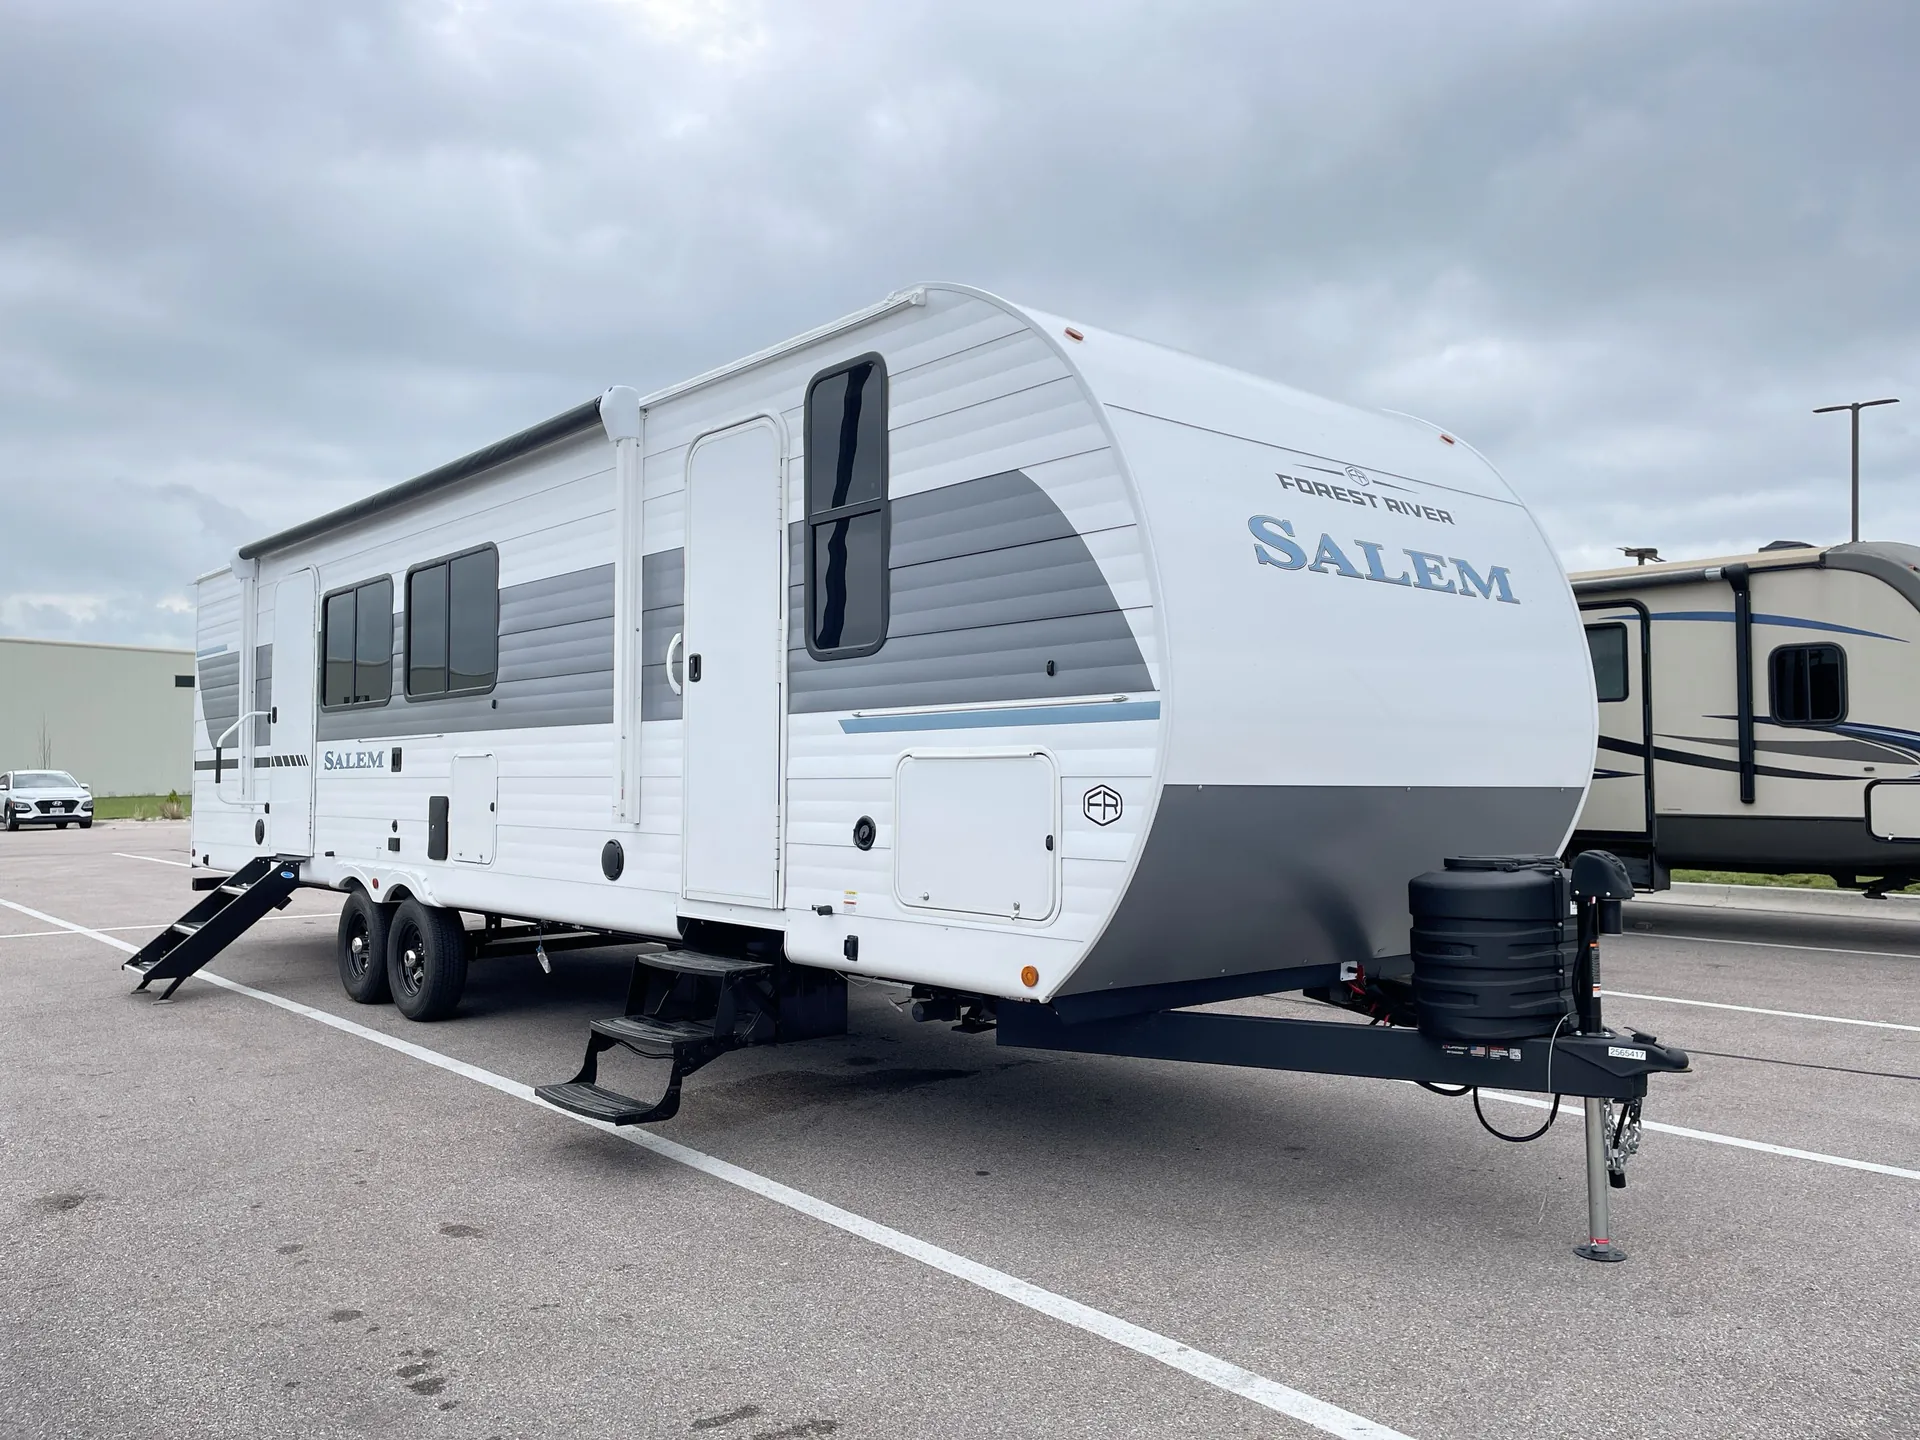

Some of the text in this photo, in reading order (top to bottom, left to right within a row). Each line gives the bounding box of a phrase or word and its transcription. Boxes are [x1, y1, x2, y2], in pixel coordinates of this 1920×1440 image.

[1275, 472, 1456, 525] FOREST RIVER
[1247, 514, 1521, 605] SALEM
[324, 750, 385, 770] SALEM
[1610, 1048, 1645, 1059] 2565417
